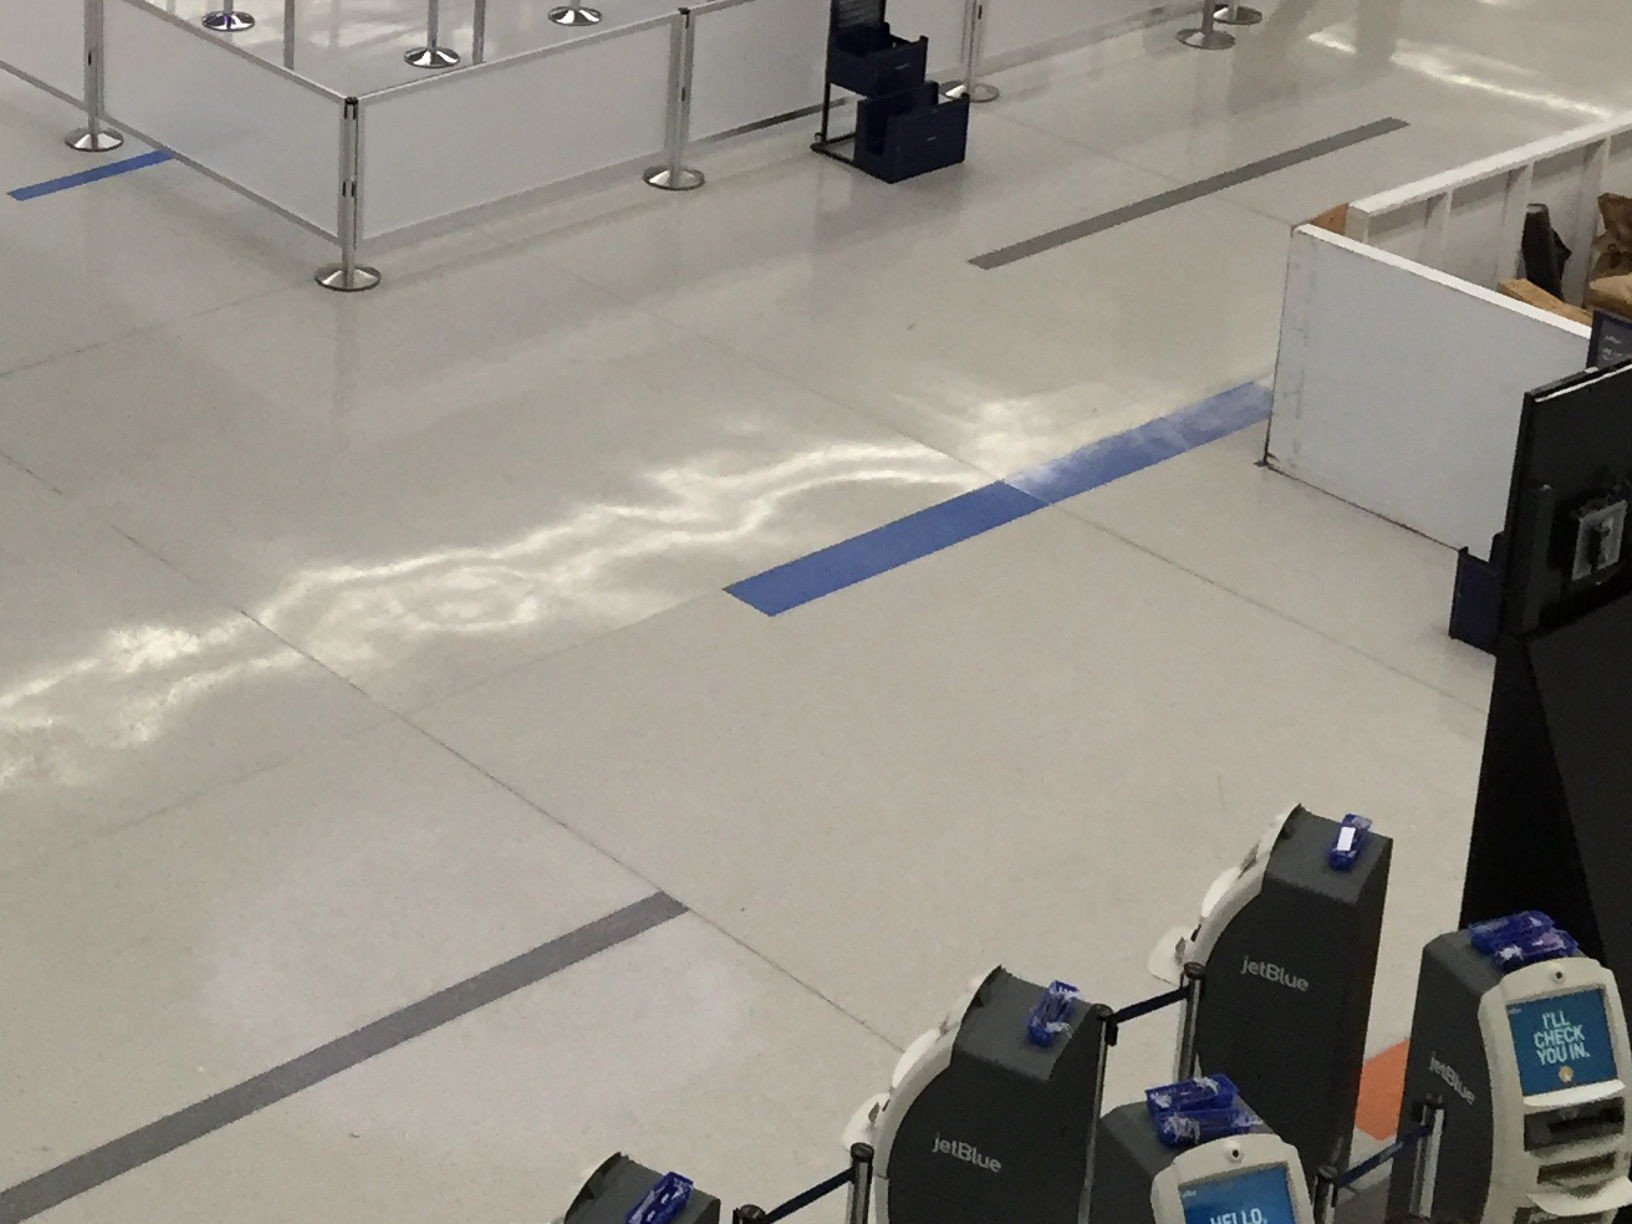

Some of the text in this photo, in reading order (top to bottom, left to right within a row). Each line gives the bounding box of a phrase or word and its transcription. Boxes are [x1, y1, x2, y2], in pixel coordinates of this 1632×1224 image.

[1240, 955, 1309, 993] jetBlue
[1542, 1010, 1571, 1030] I'LL
[1533, 1024, 1585, 1049] CHECK
[1536, 1041, 1590, 1066] YOU IN.
[1428, 1050, 1476, 1106] jetBlue
[931, 1132, 1002, 1173] jetBlue
